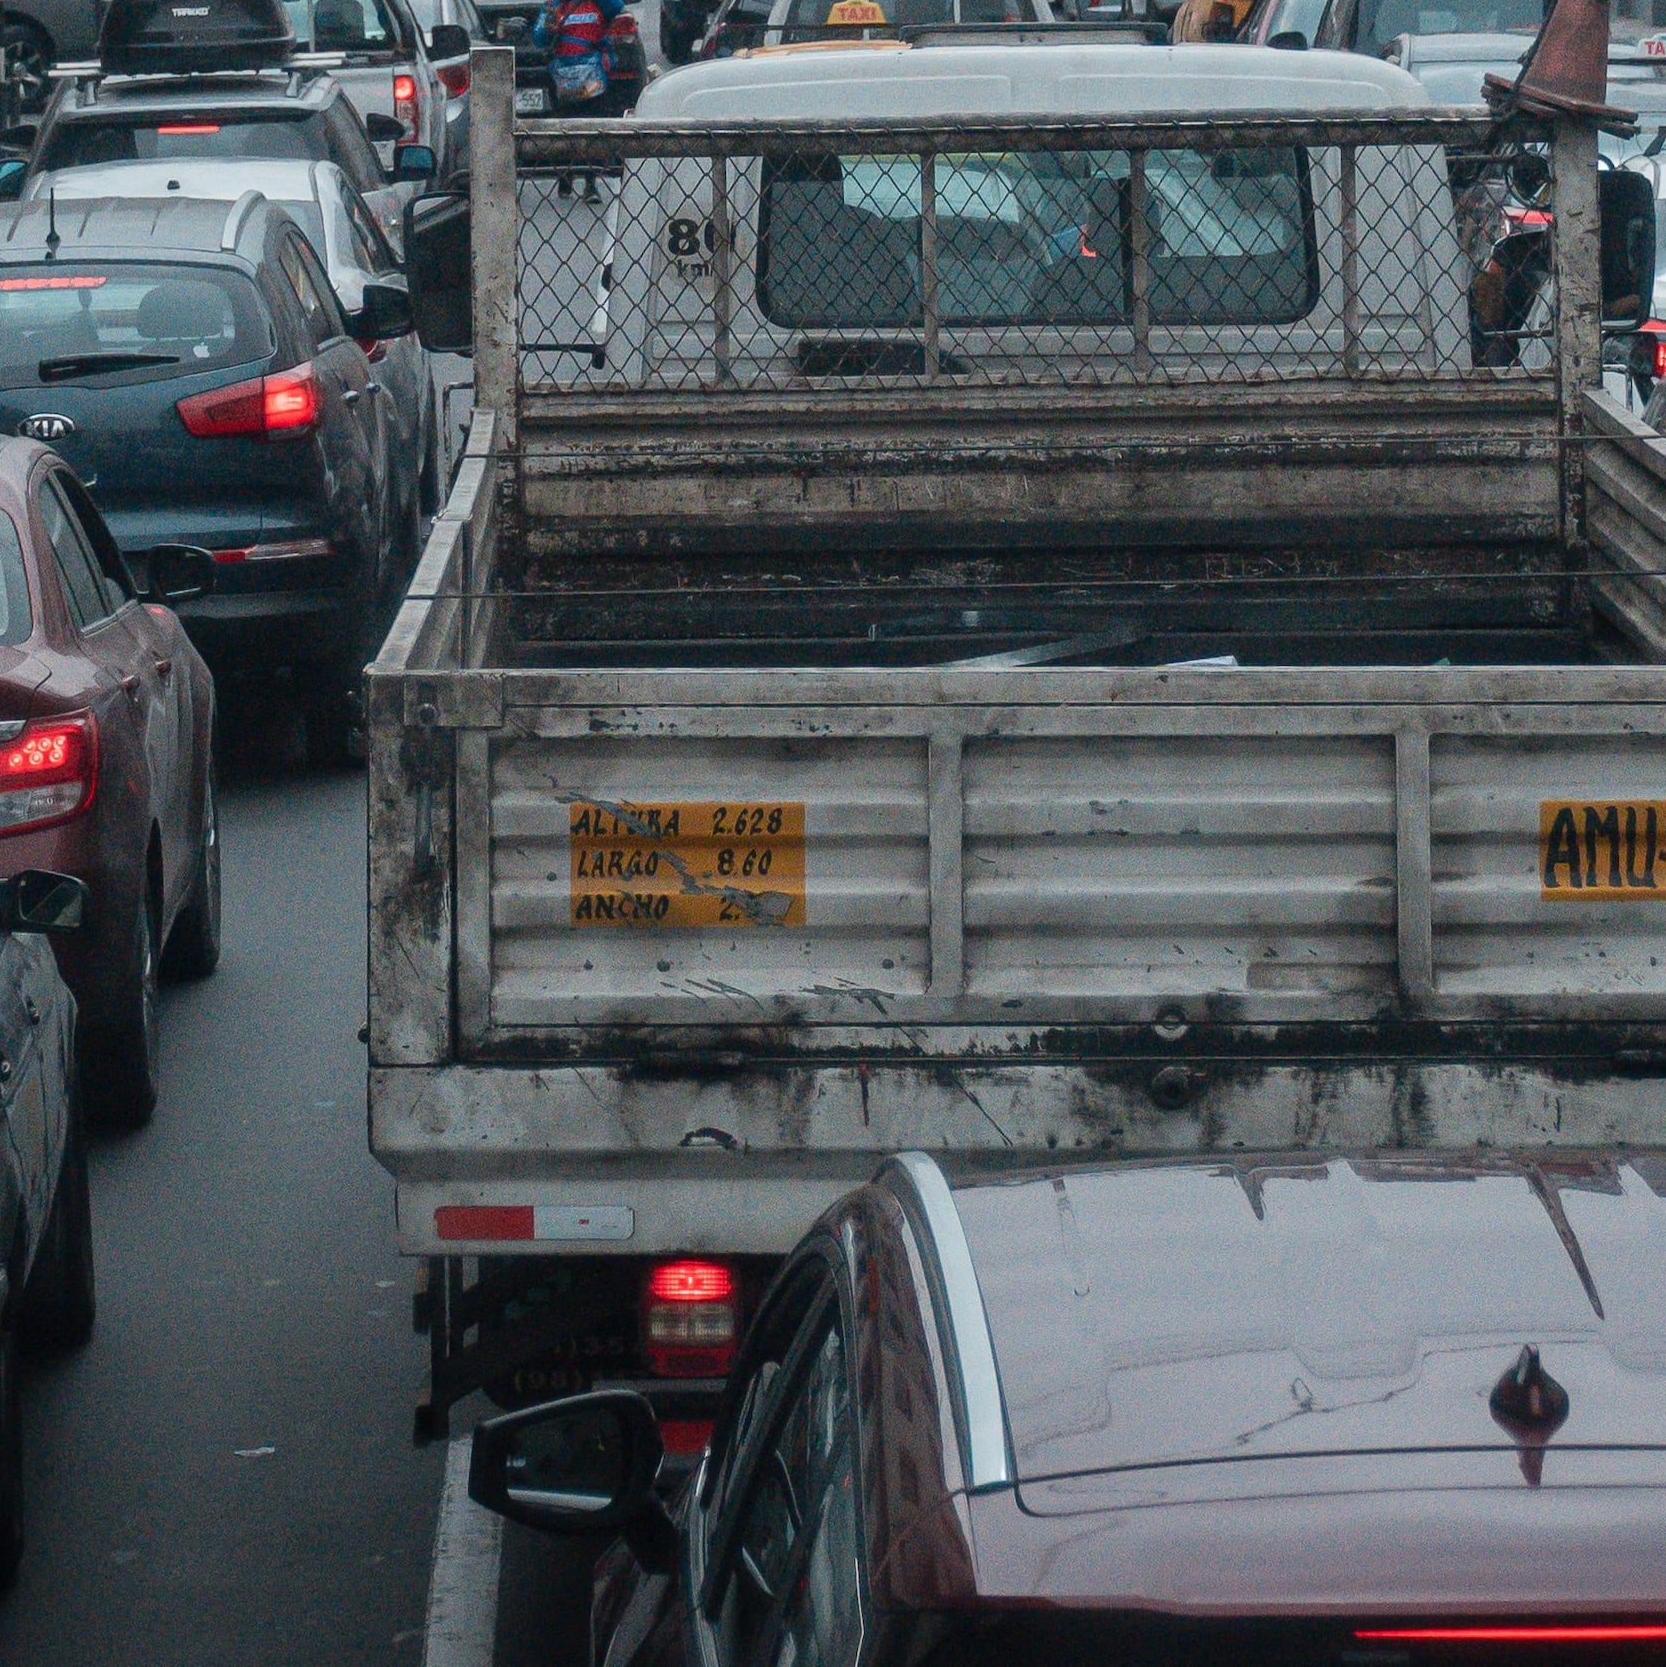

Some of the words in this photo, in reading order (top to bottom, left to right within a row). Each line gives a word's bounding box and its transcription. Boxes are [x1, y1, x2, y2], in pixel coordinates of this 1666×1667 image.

[836, 5, 879, 21] TAXI
[26, 418, 68, 438] KIA
[711, 806, 783, 836] 2.628
[576, 847, 660, 879] LARGO
[575, 892, 670, 921] ANCHO
